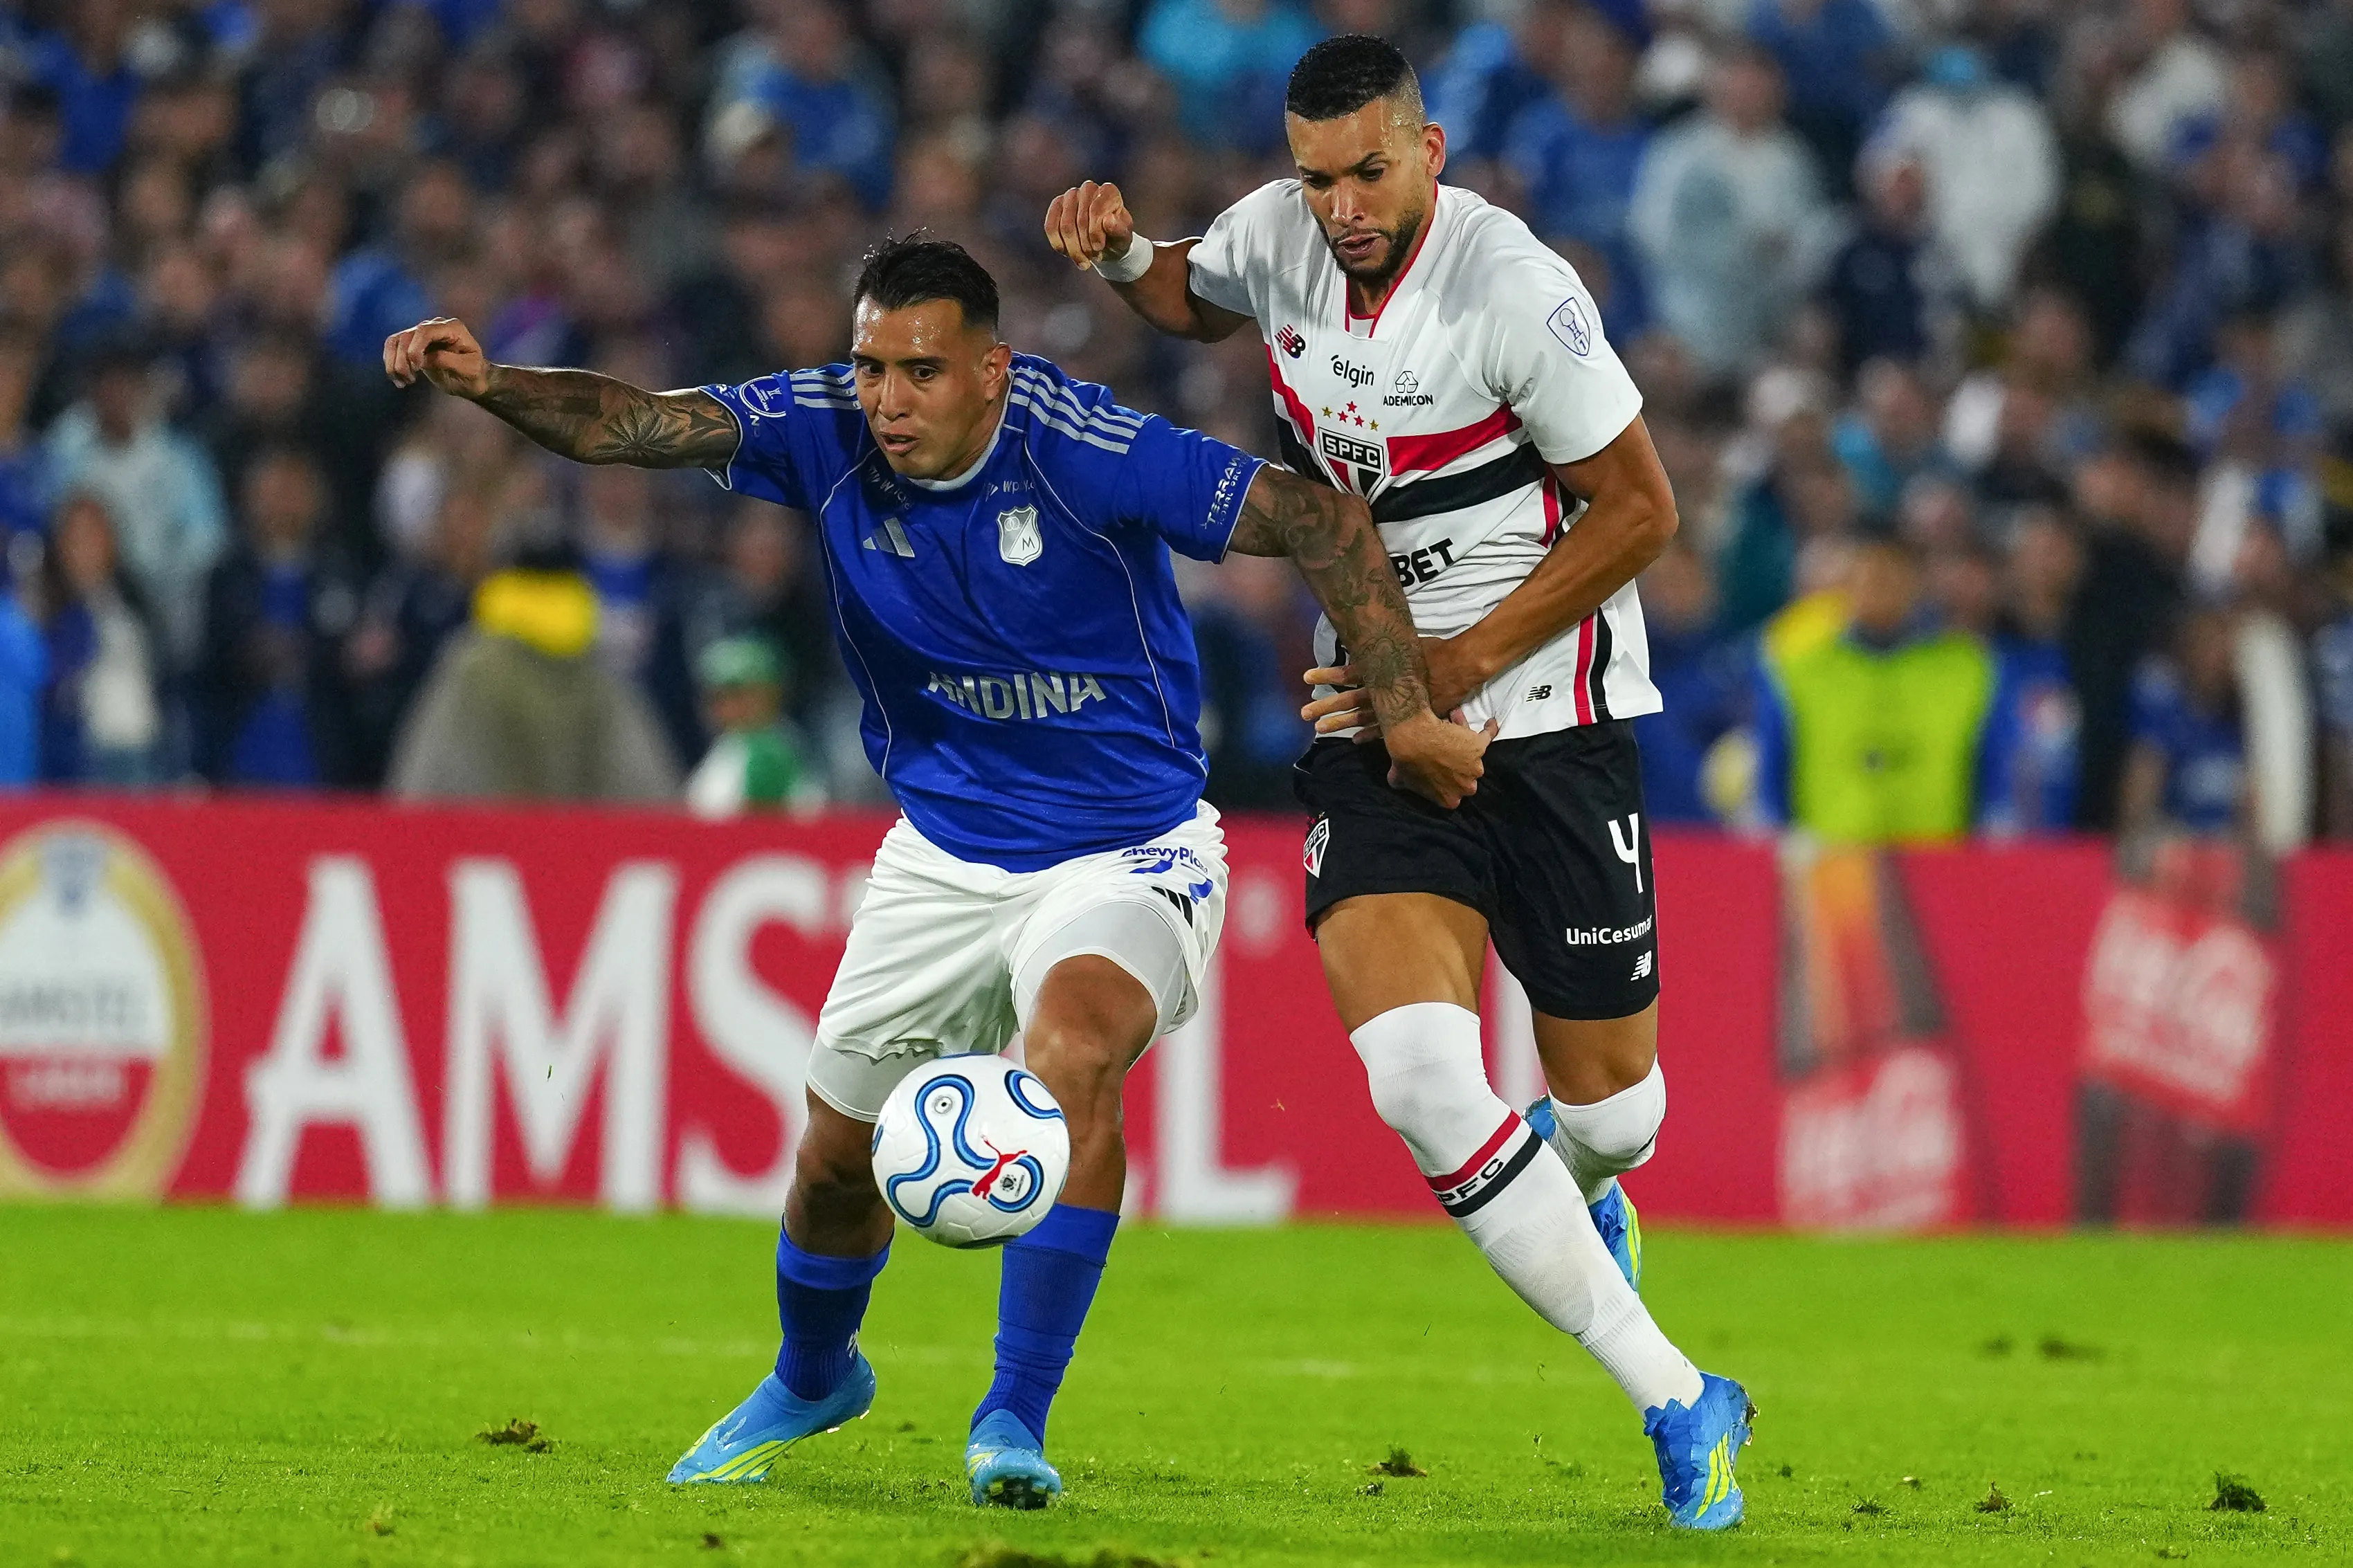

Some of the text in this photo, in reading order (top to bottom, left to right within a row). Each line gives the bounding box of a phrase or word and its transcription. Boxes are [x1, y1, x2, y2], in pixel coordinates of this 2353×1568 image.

[1383, 394, 1434, 407] ADEMICON
[1325, 436, 1379, 466] SPFC
[1022, 536, 1035, 551] M
[1304, 824, 1325, 856] SPFC
[1607, 812, 1644, 894] 4
[1565, 913, 1653, 945] UniCesuma
[234, 851, 1296, 1219] AMSL
